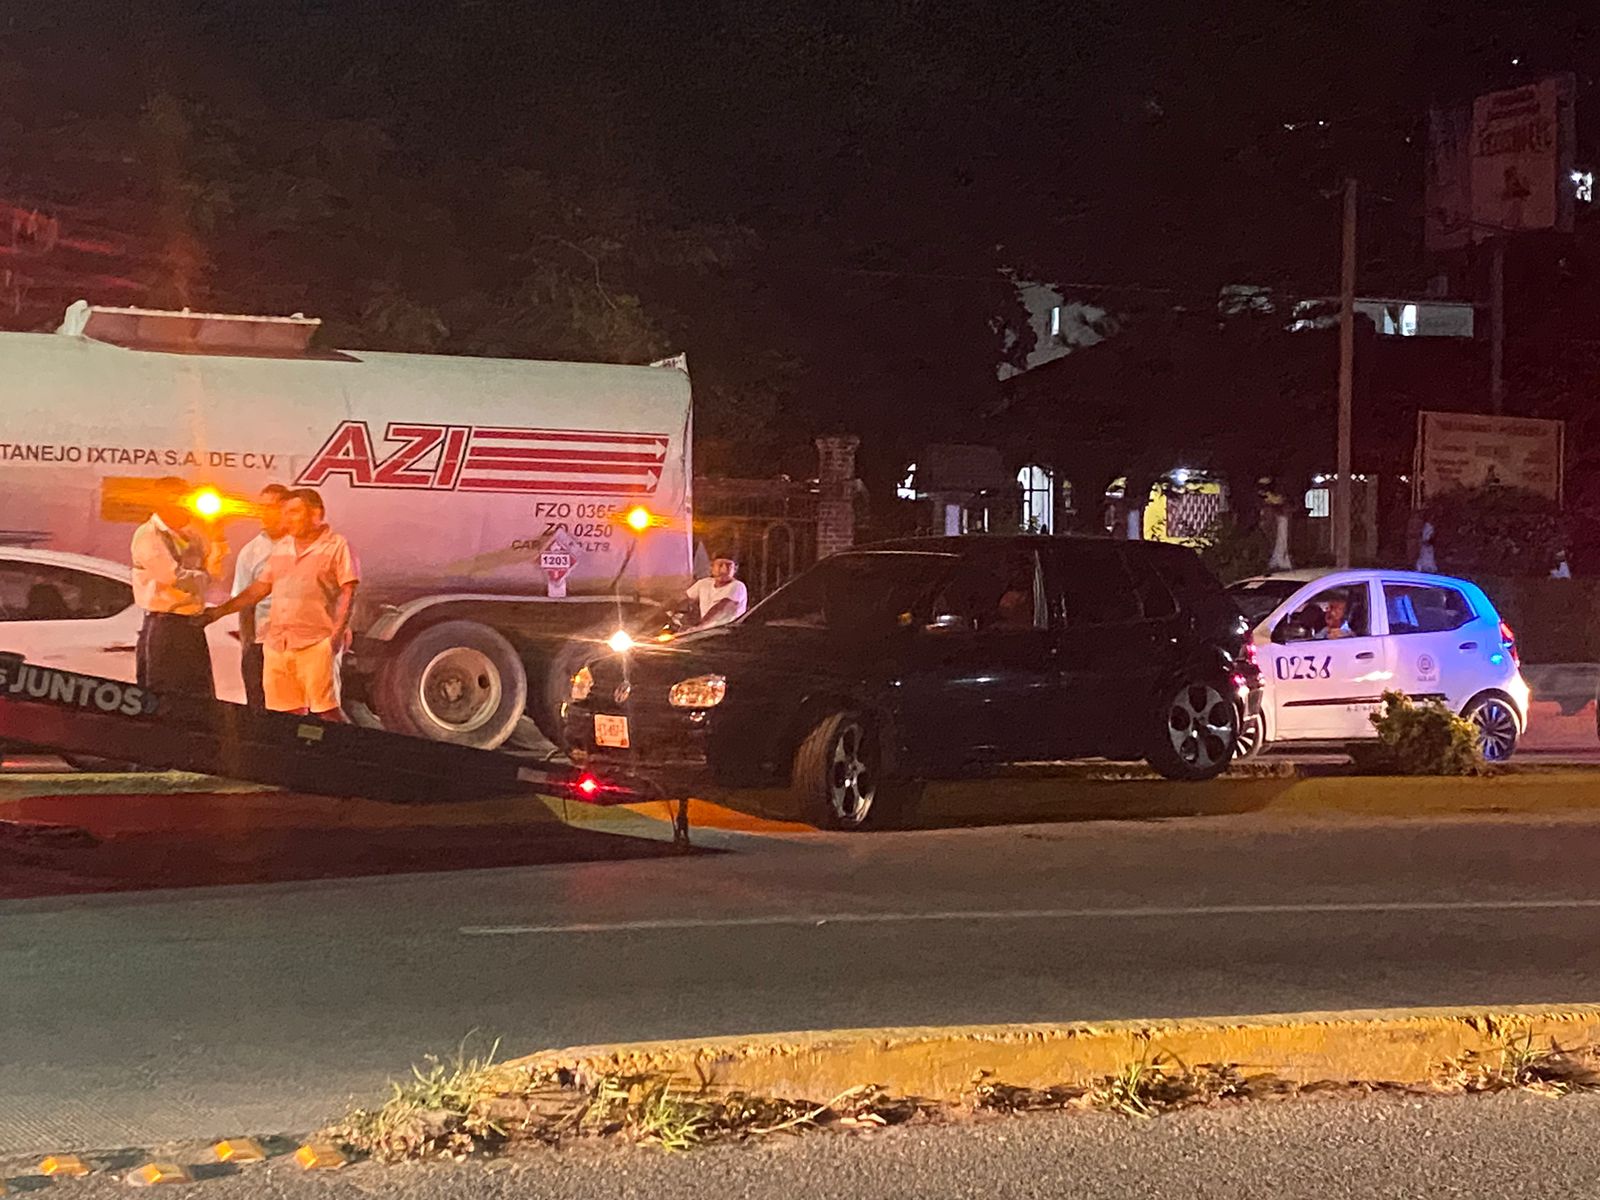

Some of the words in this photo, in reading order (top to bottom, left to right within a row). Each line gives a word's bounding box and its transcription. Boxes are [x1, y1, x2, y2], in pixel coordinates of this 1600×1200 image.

[0, 443, 82, 463] TANEJO
[87, 446, 161, 466] IXTAPA
[164, 449, 202, 467] S.A.
[208, 451, 237, 468] DE
[241, 453, 279, 470] C.V.
[295, 420, 472, 490] AZI
[534, 502, 571, 519] FZO
[573, 523, 613, 538] 0250
[543, 555, 569, 567] 1203
[1275, 655, 1332, 681] 0236
[9, 666, 144, 716] JUNTOS
